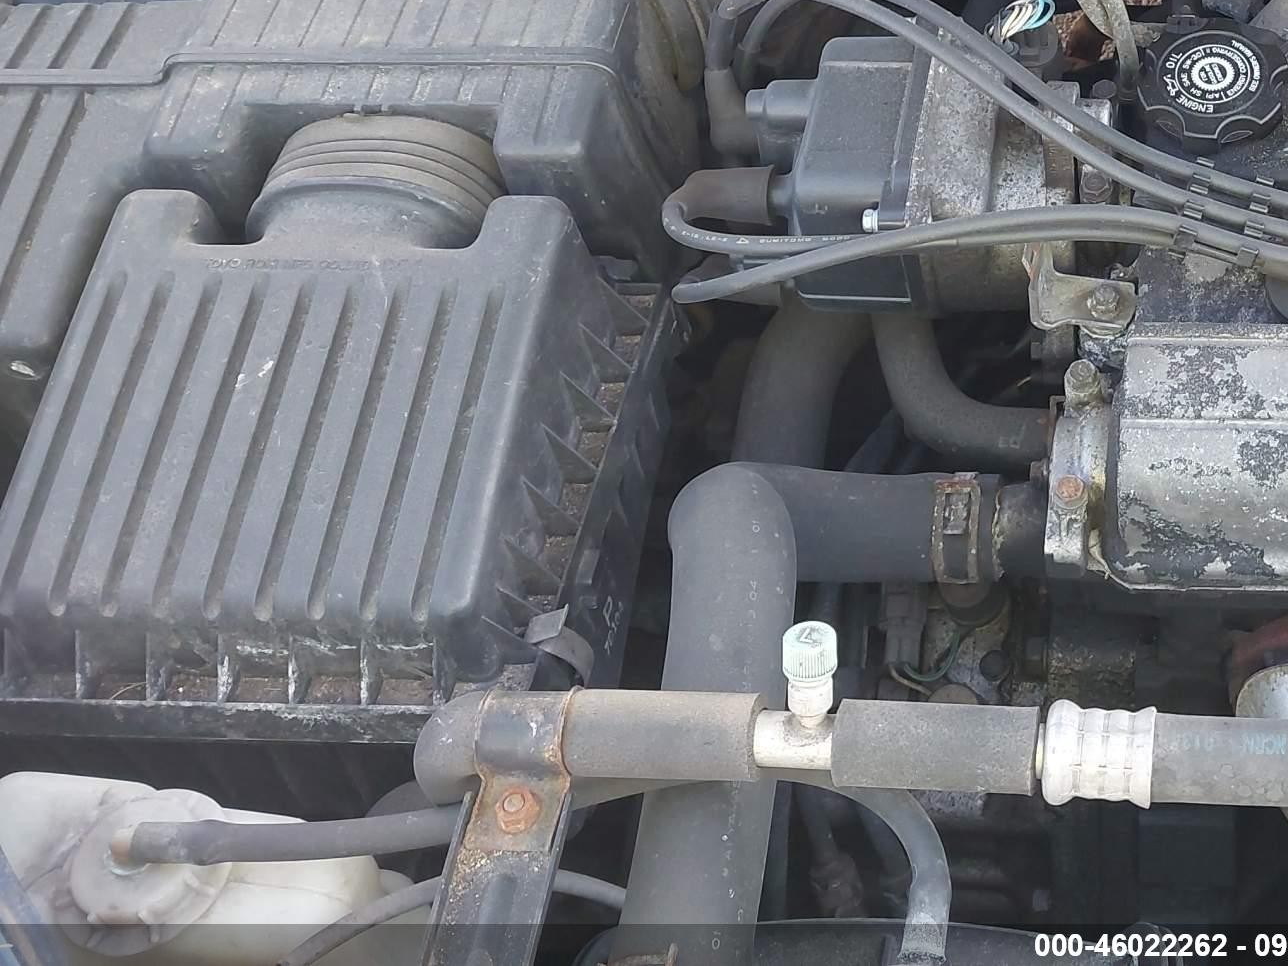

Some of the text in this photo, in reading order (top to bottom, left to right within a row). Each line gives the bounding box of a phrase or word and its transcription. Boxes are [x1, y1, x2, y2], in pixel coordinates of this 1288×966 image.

[1165, 52, 1183, 69] OIL
[1180, 72, 1191, 87] SAE
[1190, 87, 1203, 97] SH
[1205, 90, 1220, 99] API
[1176, 94, 1214, 113] ENGINE
